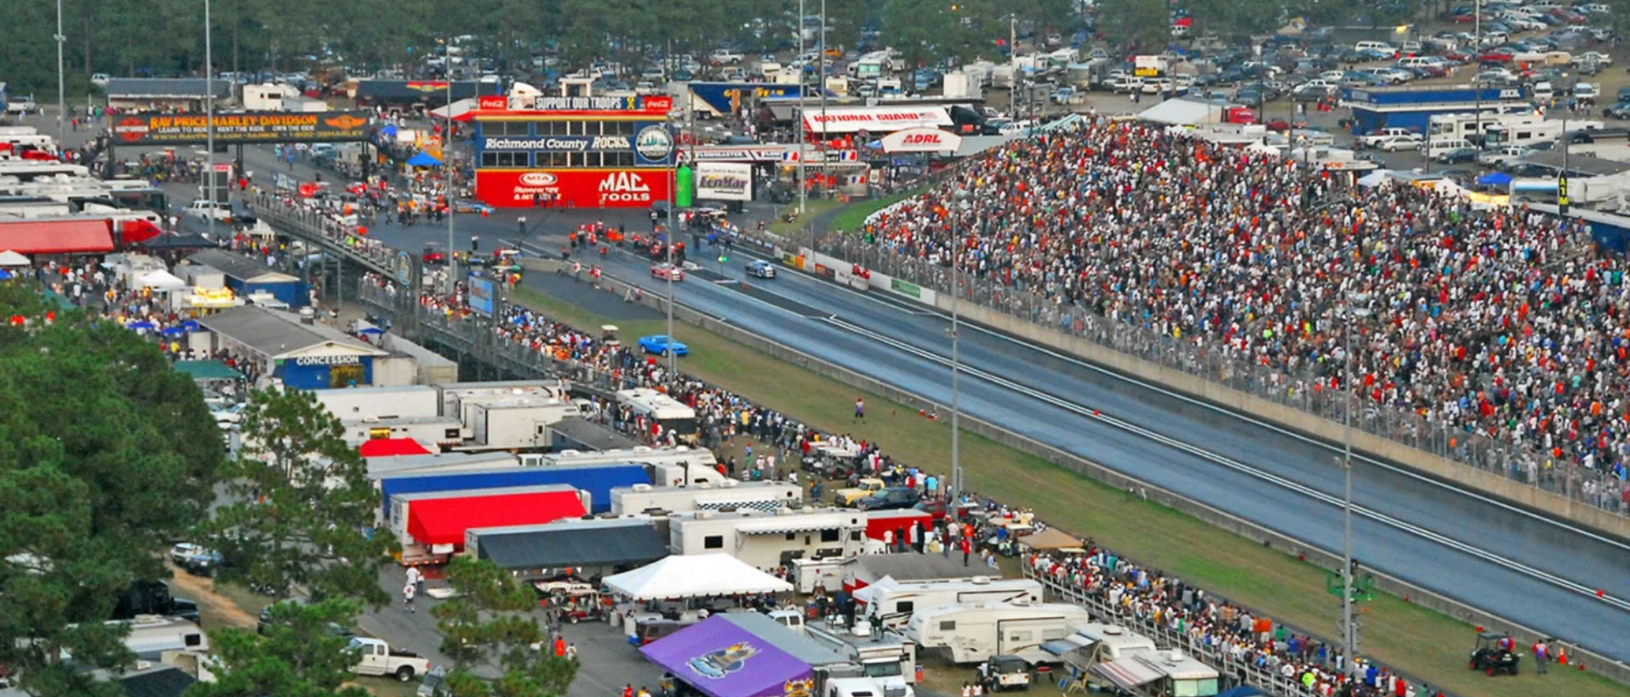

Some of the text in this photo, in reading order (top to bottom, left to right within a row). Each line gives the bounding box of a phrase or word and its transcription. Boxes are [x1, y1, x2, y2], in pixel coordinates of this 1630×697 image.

[536, 97, 622, 109] SUPPORT OUR TROOPS
[150, 116, 172, 129] RAY
[174, 116, 208, 127] PRICE
[813, 112, 920, 123] NATIONAL GUARD
[486, 136, 631, 150] Richmond County ROCKS
[903, 134, 942, 143] ADRL
[598, 171, 651, 192] MAC
[600, 193, 651, 201] TOOLS
[296, 355, 360, 366] CONCESSION
